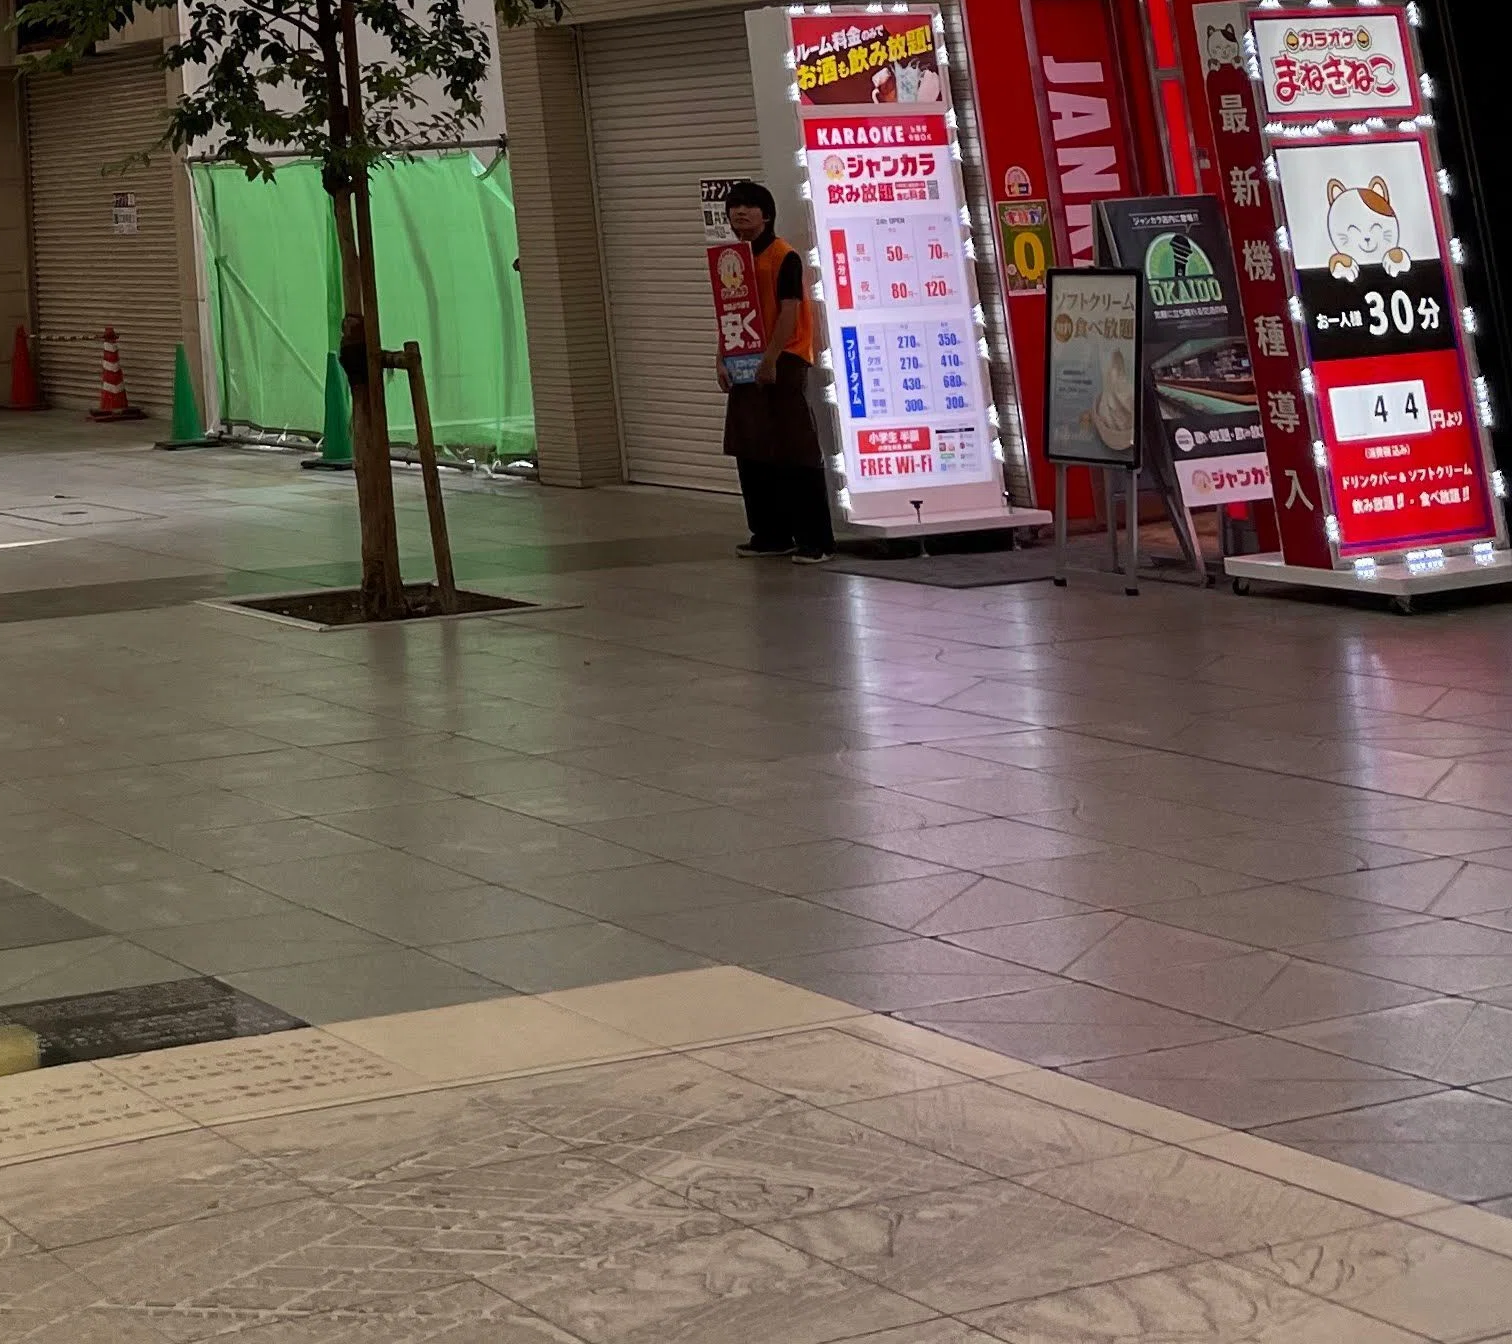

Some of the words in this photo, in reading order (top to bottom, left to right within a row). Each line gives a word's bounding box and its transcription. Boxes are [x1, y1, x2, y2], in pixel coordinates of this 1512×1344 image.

[796, 24, 885, 64] ルーム料金のみで
[1298, 29, 1355, 49] カラオケ
[1273, 52, 1398, 104] まねきねこ
[815, 124, 906, 147] KARAOKE
[846, 152, 936, 179] ジャンカラ
[827, 182, 895, 205] 飲み放題
[1054, 291, 1135, 312] ソフトクリーム
[1218, 93, 1315, 512] 最新機種導入
[1074, 317, 1134, 341] 食べ放題
[845, 339, 862, 406] フリータイム
[859, 456, 893, 477] FREE
[1211, 466, 1270, 490] ジャンカ
